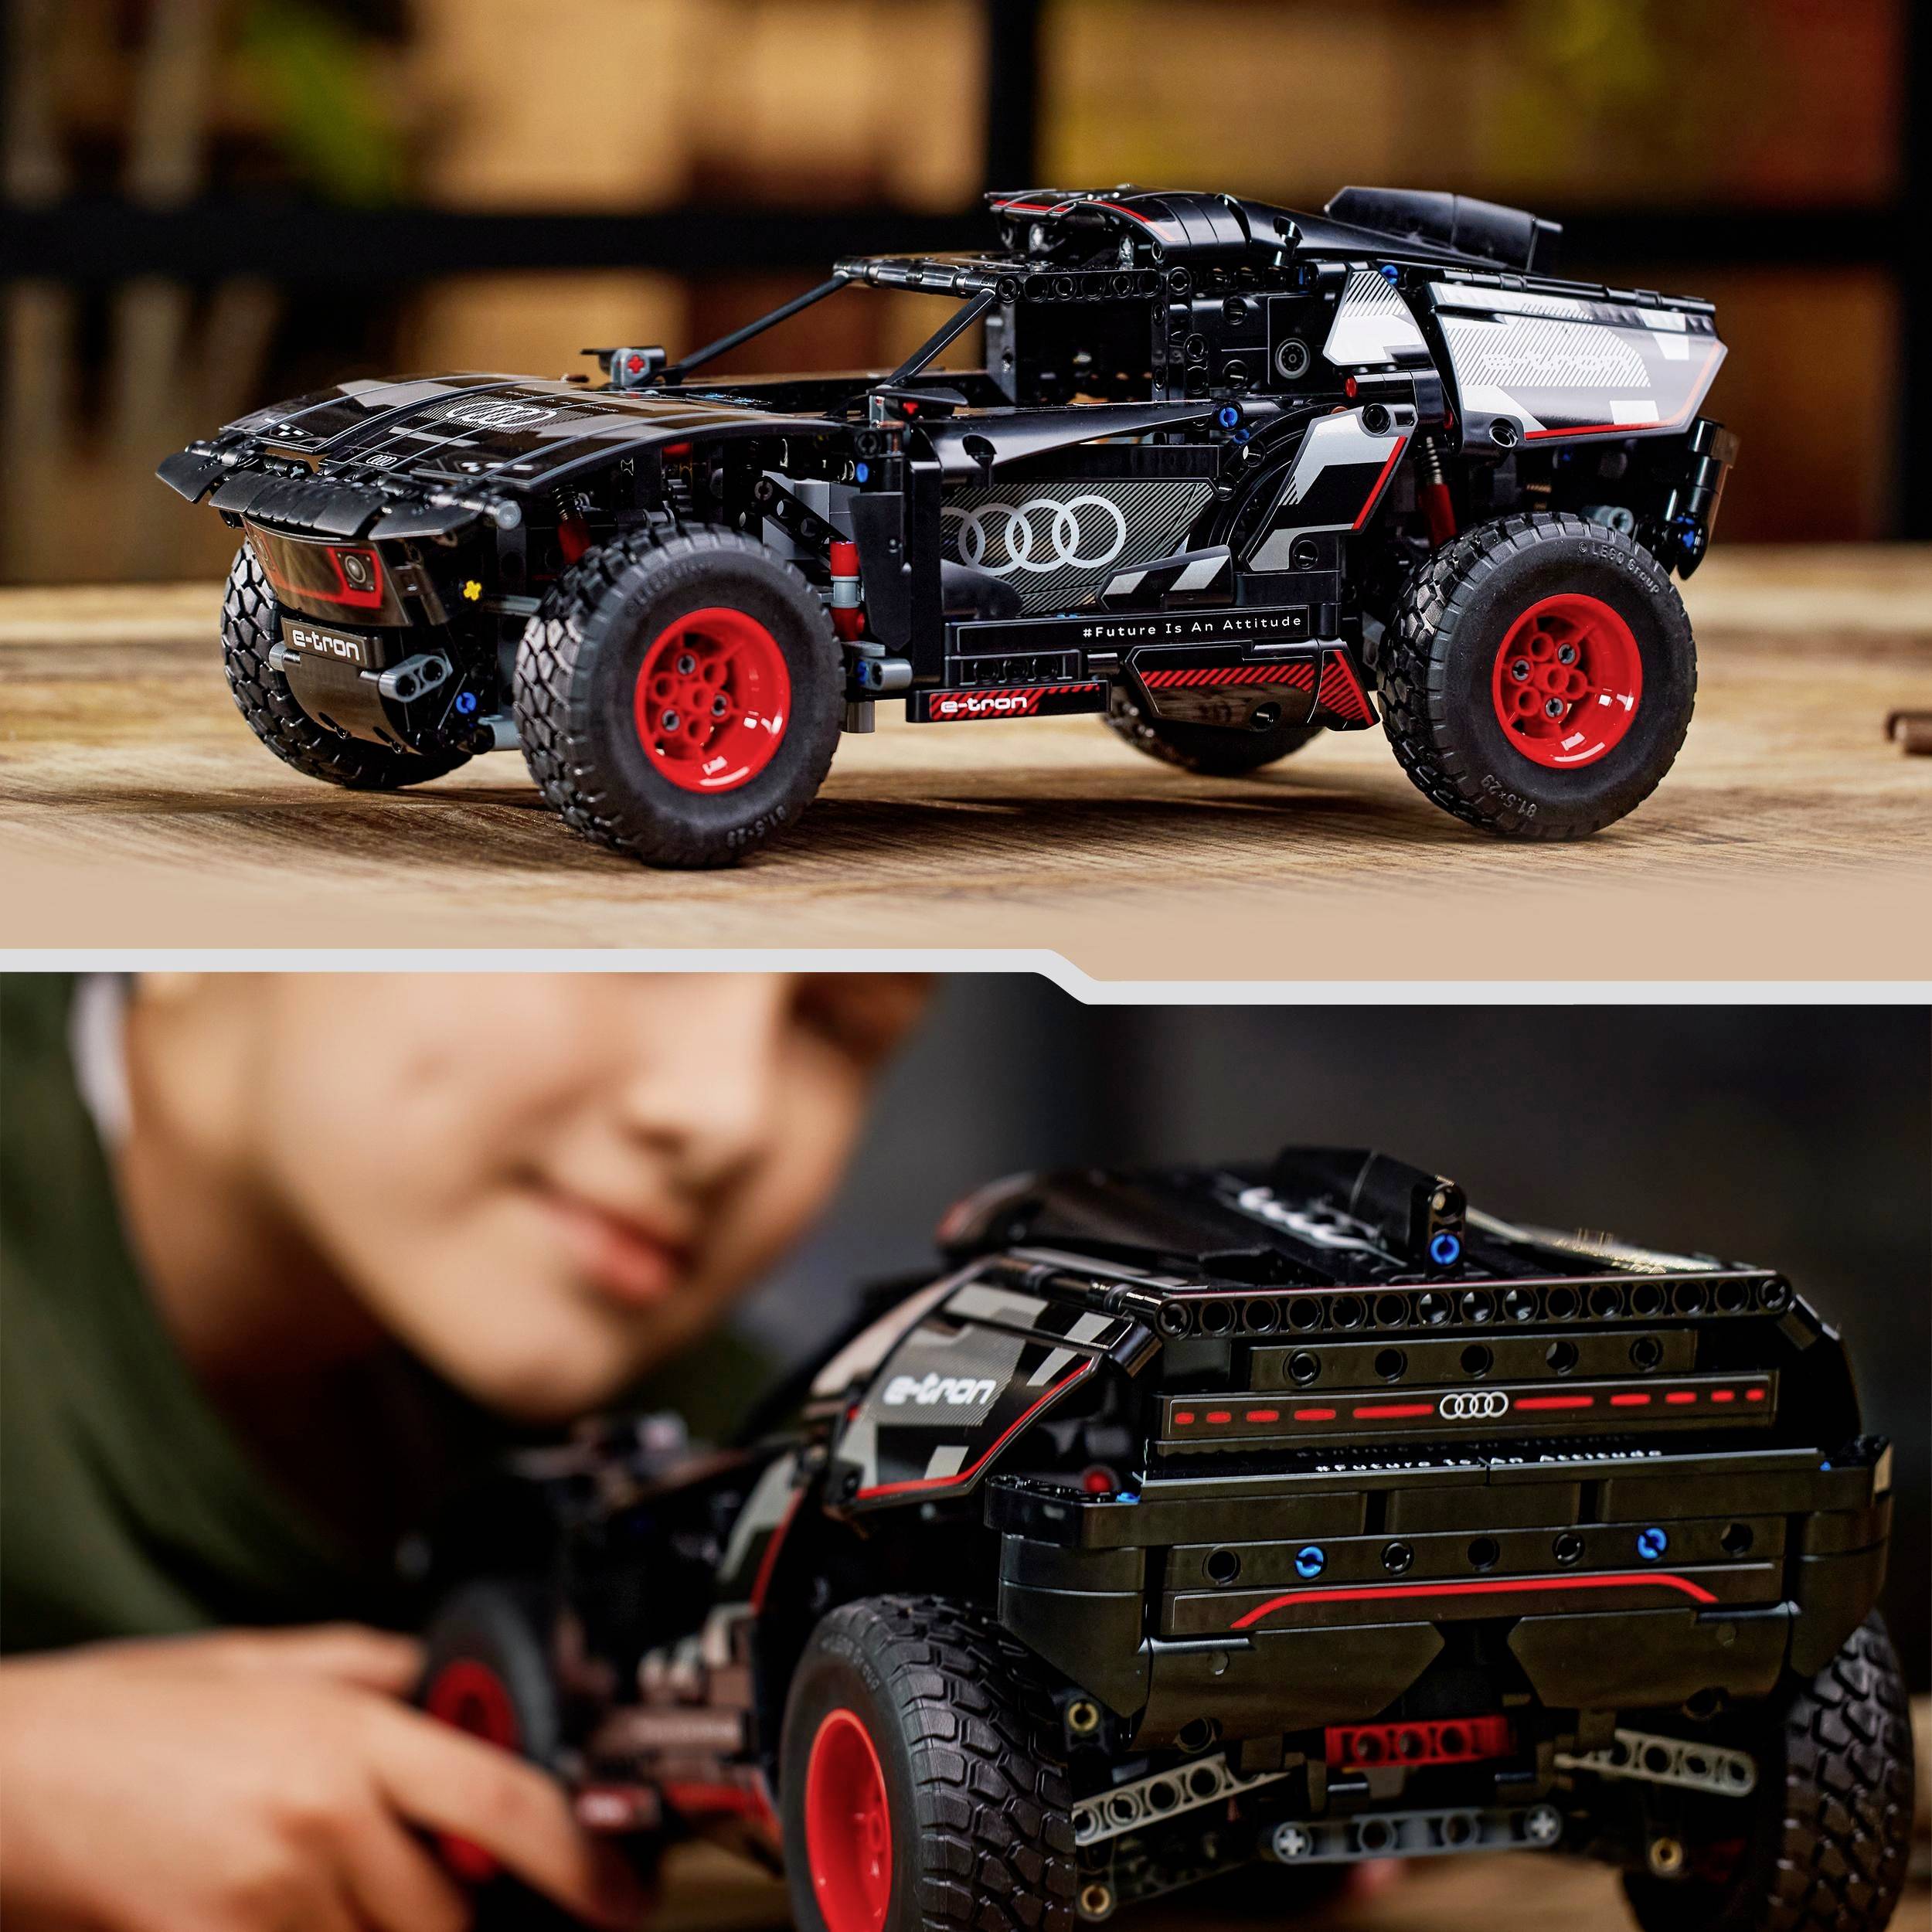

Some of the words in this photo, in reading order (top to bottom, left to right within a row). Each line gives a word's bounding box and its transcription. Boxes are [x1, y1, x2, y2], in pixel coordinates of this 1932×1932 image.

[1592, 542, 1625, 565] LEGO
[1627, 558, 1660, 594] Group
[1082, 624, 1157, 638] #Future
[1165, 623, 1183, 634] Is
[1192, 621, 1214, 632] An
[1223, 615, 1303, 631] Attitude
[292, 628, 362, 662] e-tron
[940, 696, 1029, 714] e-tron
[883, 1372, 998, 1406] e-tron
